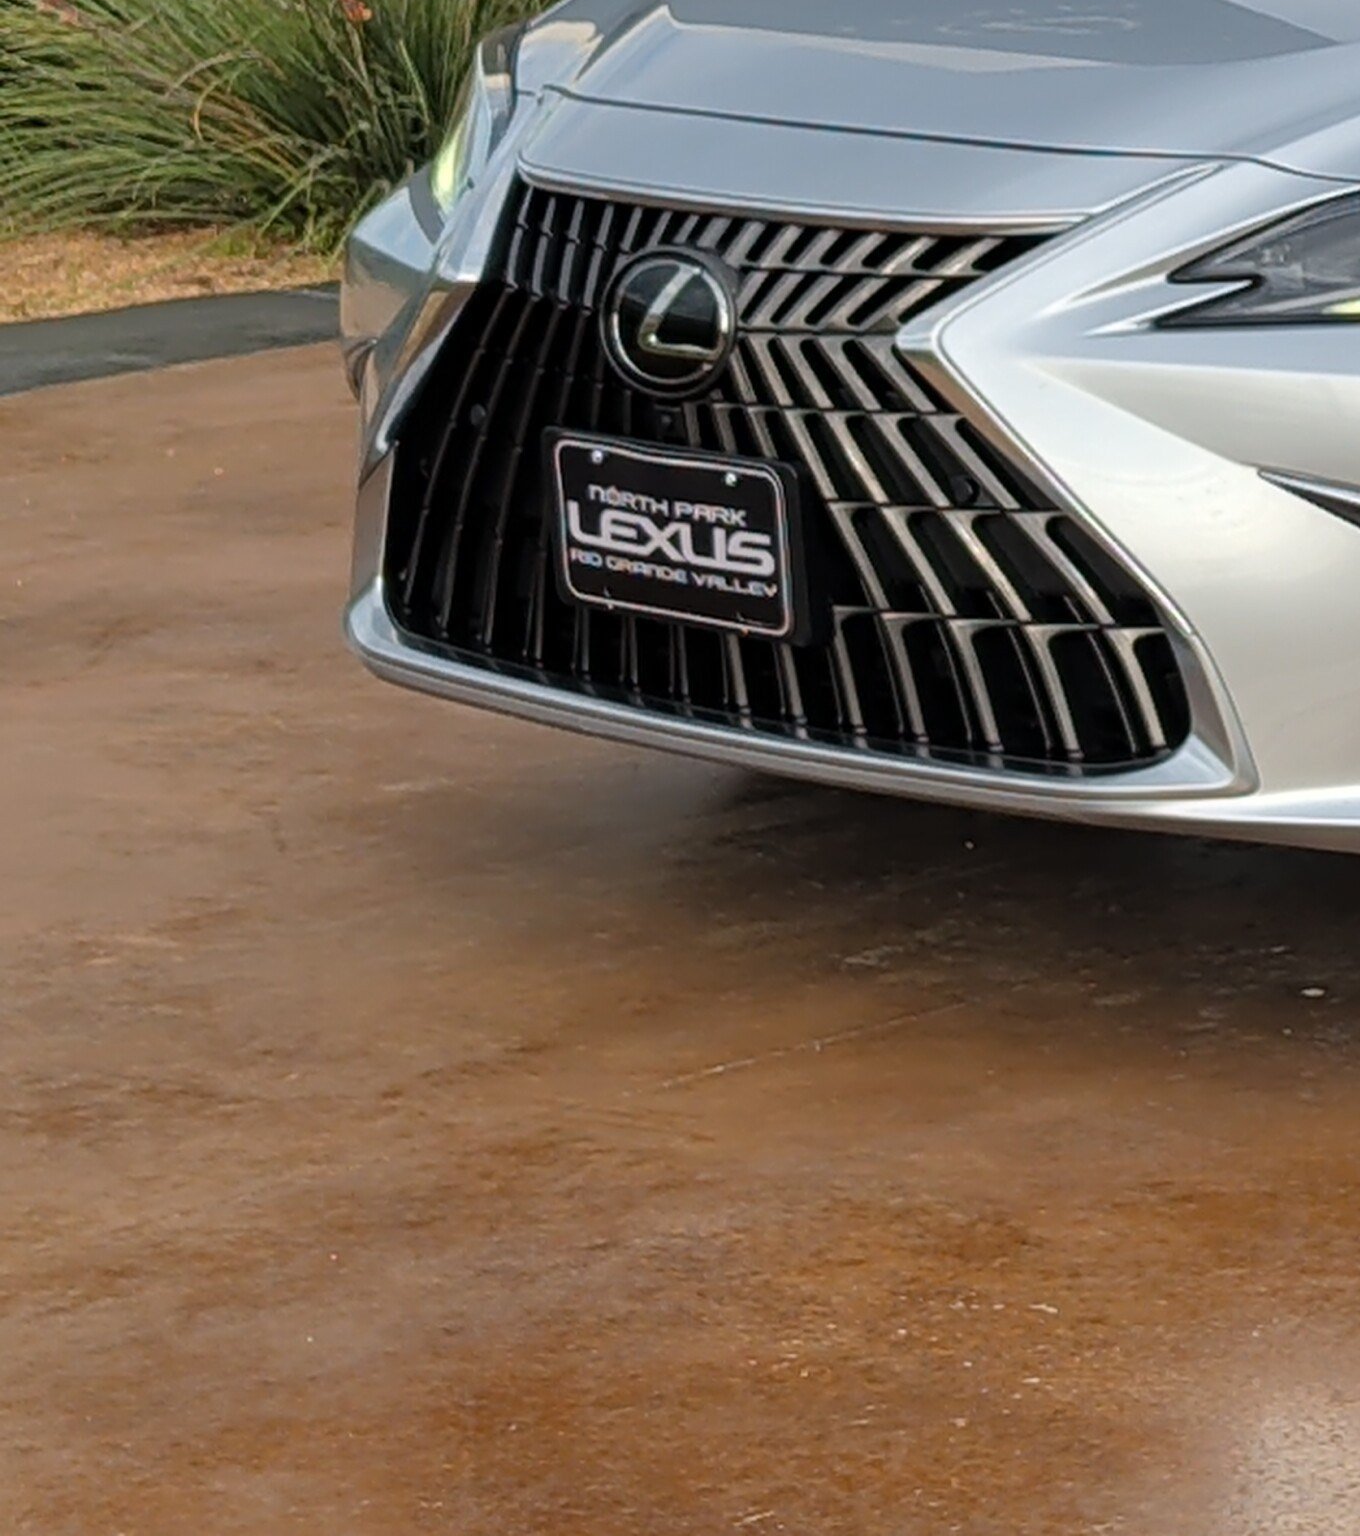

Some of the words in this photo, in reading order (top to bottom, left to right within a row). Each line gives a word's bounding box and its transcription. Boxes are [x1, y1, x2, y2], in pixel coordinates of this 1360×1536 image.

[586, 482, 670, 517] NORTH
[673, 499, 748, 528] PARK
[566, 498, 776, 576] LEXUS
[569, 546, 604, 569] RIO
[605, 554, 689, 586] GRANDE
[692, 570, 778, 599] VALLEY
